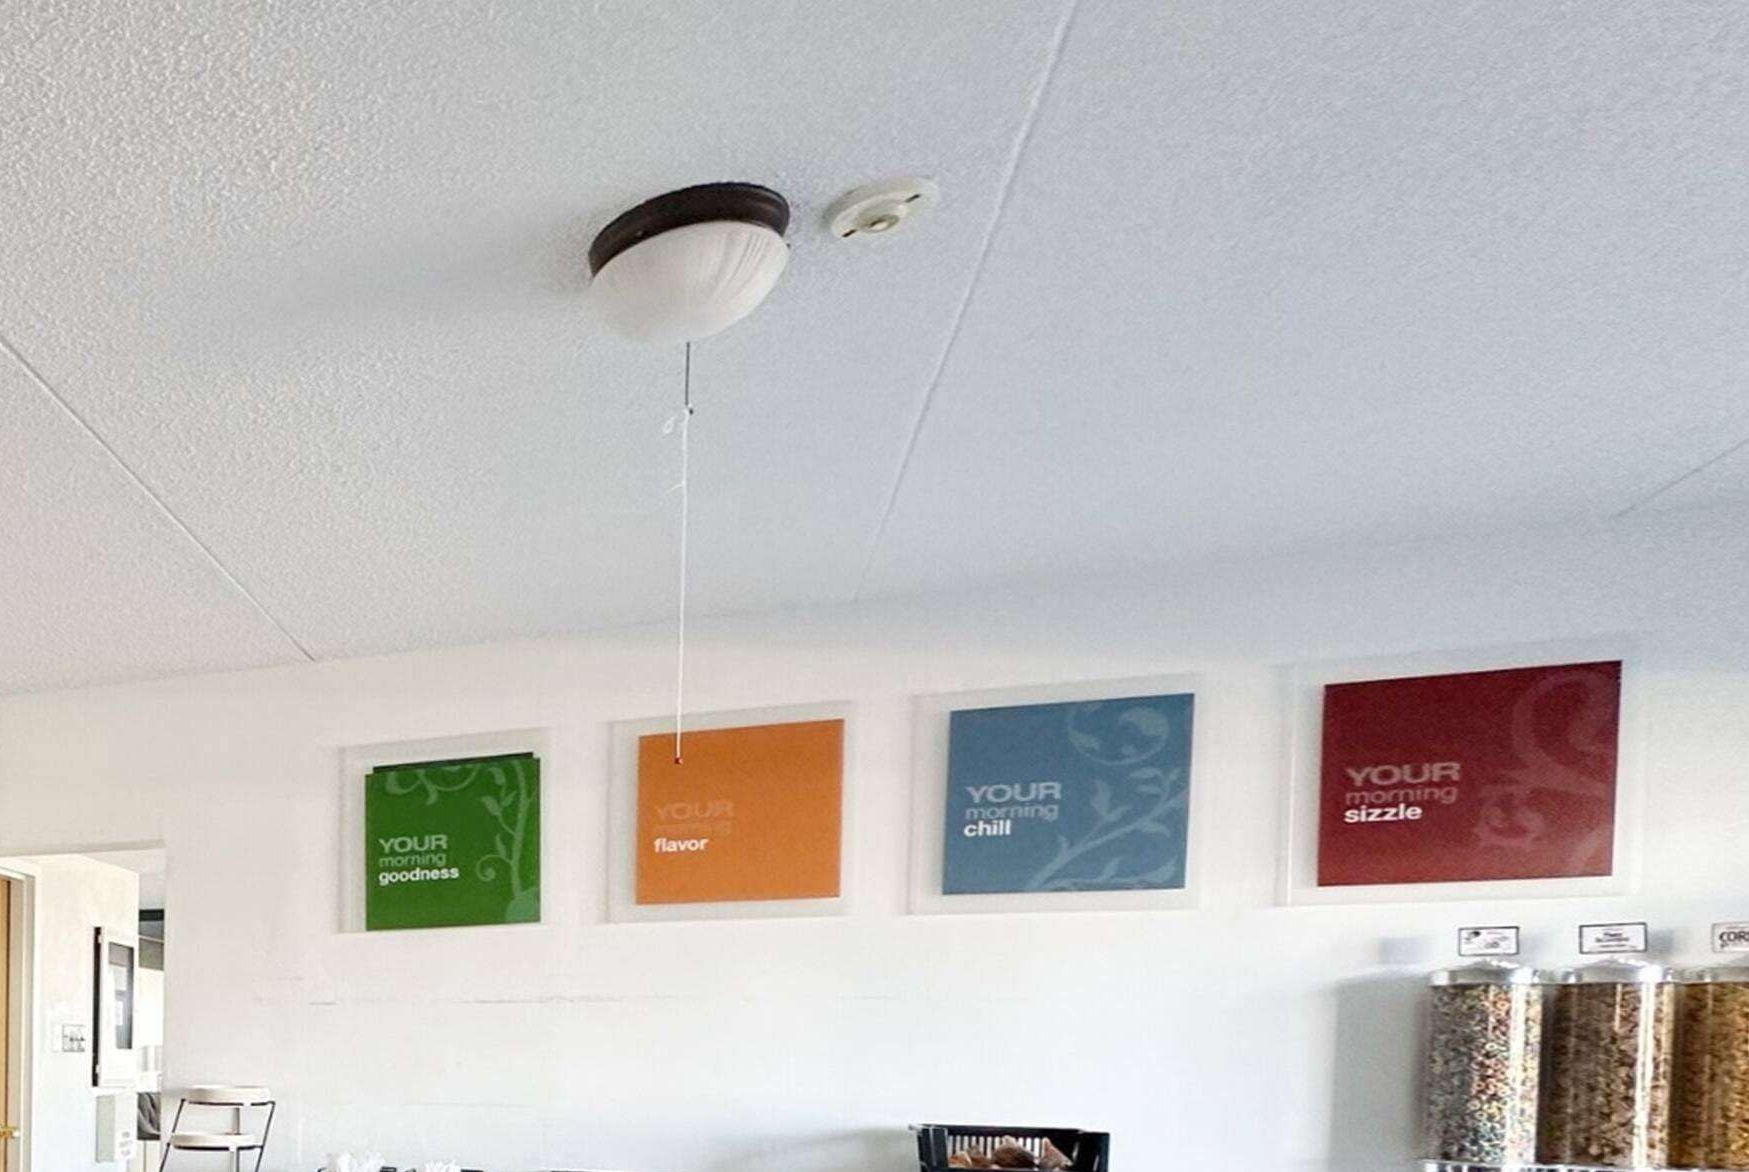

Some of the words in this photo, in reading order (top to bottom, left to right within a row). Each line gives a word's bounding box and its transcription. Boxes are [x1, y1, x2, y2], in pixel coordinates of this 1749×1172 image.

[1345, 762, 1461, 786] YOUR
[965, 782, 1063, 804] YOUR
[1344, 783, 1459, 807] morning
[654, 801, 735, 821] YOUR
[964, 802, 1060, 823] morning
[1343, 803, 1423, 824] sizzle
[963, 820, 1012, 838] chill
[378, 834, 448, 853] YOUR
[653, 836, 708, 853] flavor
[378, 851, 447, 870] morning
[378, 866, 460, 886] goodness
[1719, 930, 1749, 942] COR
